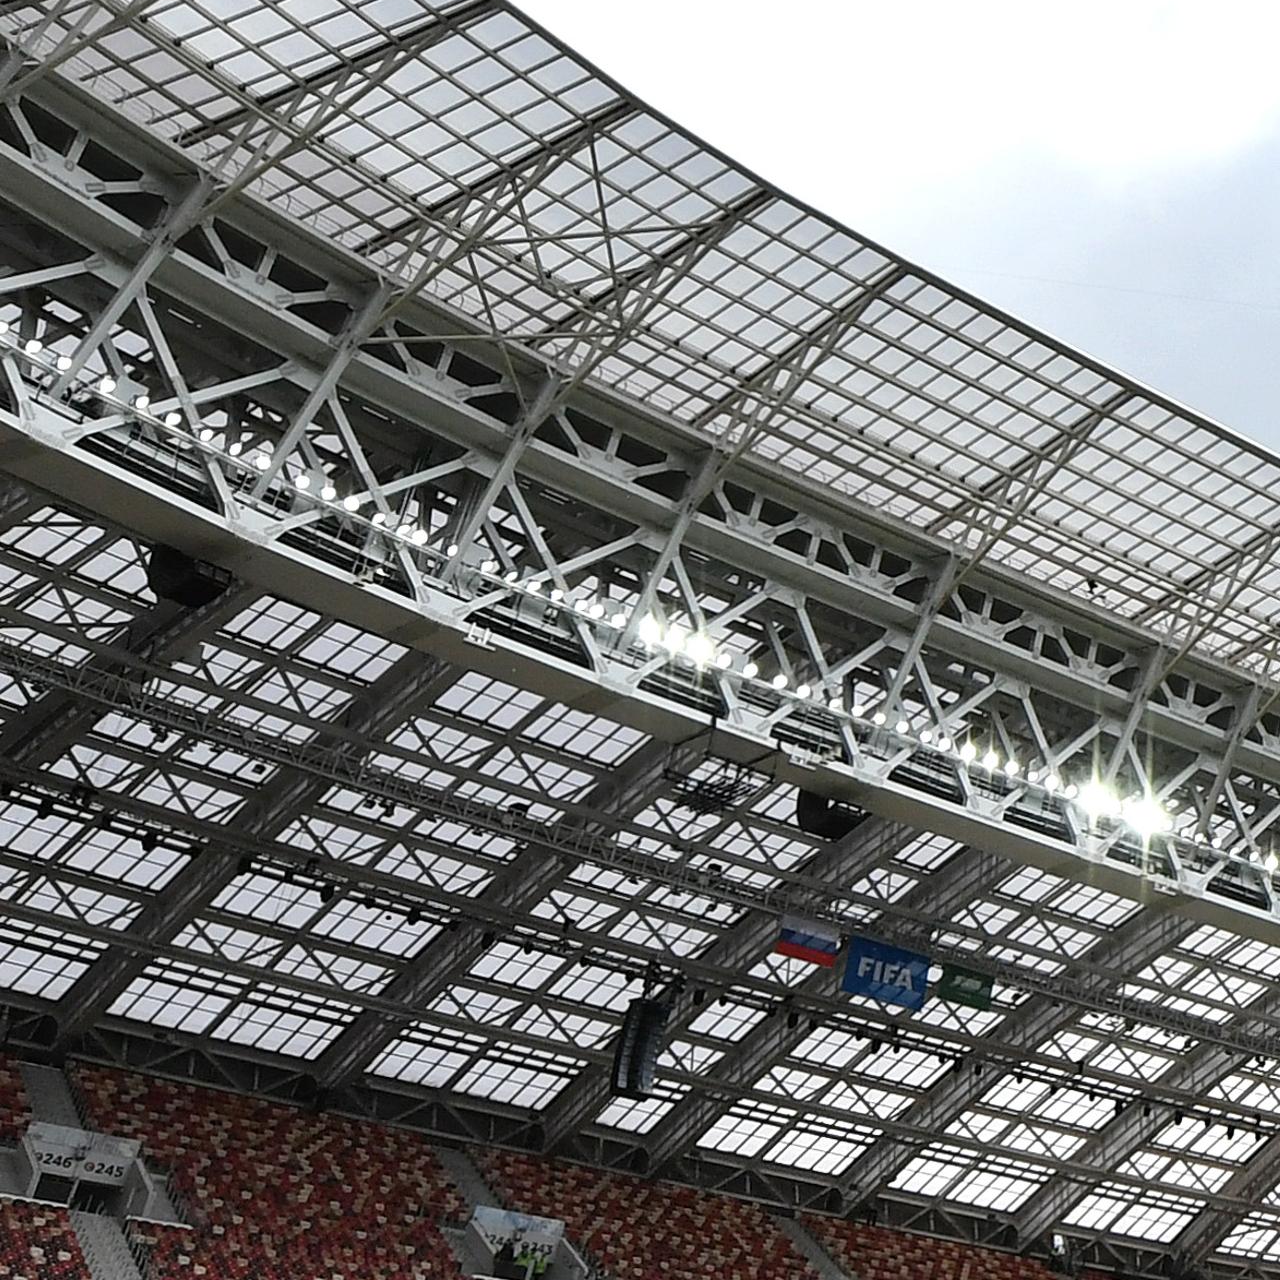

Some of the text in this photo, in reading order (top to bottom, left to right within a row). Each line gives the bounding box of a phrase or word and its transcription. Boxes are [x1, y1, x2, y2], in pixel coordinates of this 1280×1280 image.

[857, 956, 913, 991] FIFA
[43, 1153, 124, 1179] 246 245
